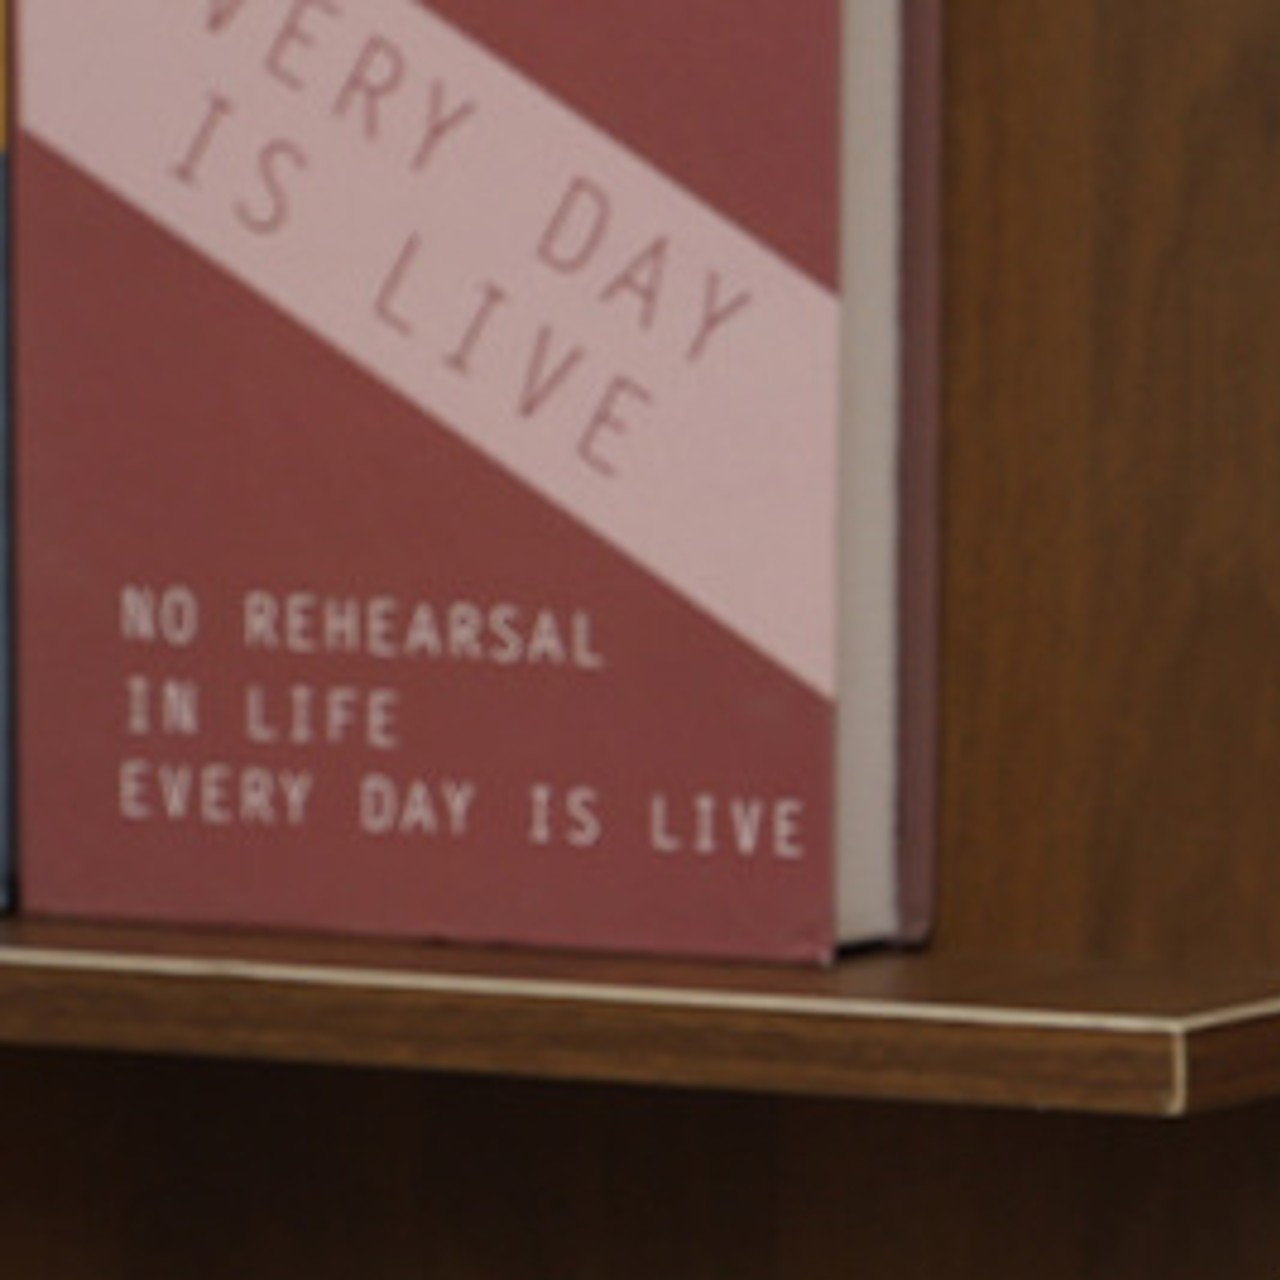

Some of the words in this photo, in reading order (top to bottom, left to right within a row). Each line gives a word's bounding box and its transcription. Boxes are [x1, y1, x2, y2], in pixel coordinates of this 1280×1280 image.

[167, 90, 309, 237] IS
[373, 232, 653, 480] LIVE
[535, 175, 753, 365] DAY
[119, 585, 197, 646] NO
[244, 590, 605, 670] REHEARSAL
[124, 677, 199, 735] IN
[245, 683, 401, 748] LIFE
[119, 758, 313, 827] EVERY
[360, 776, 476, 834] DAY
[529, 786, 602, 846] IS
[651, 793, 805, 858] LIVE
